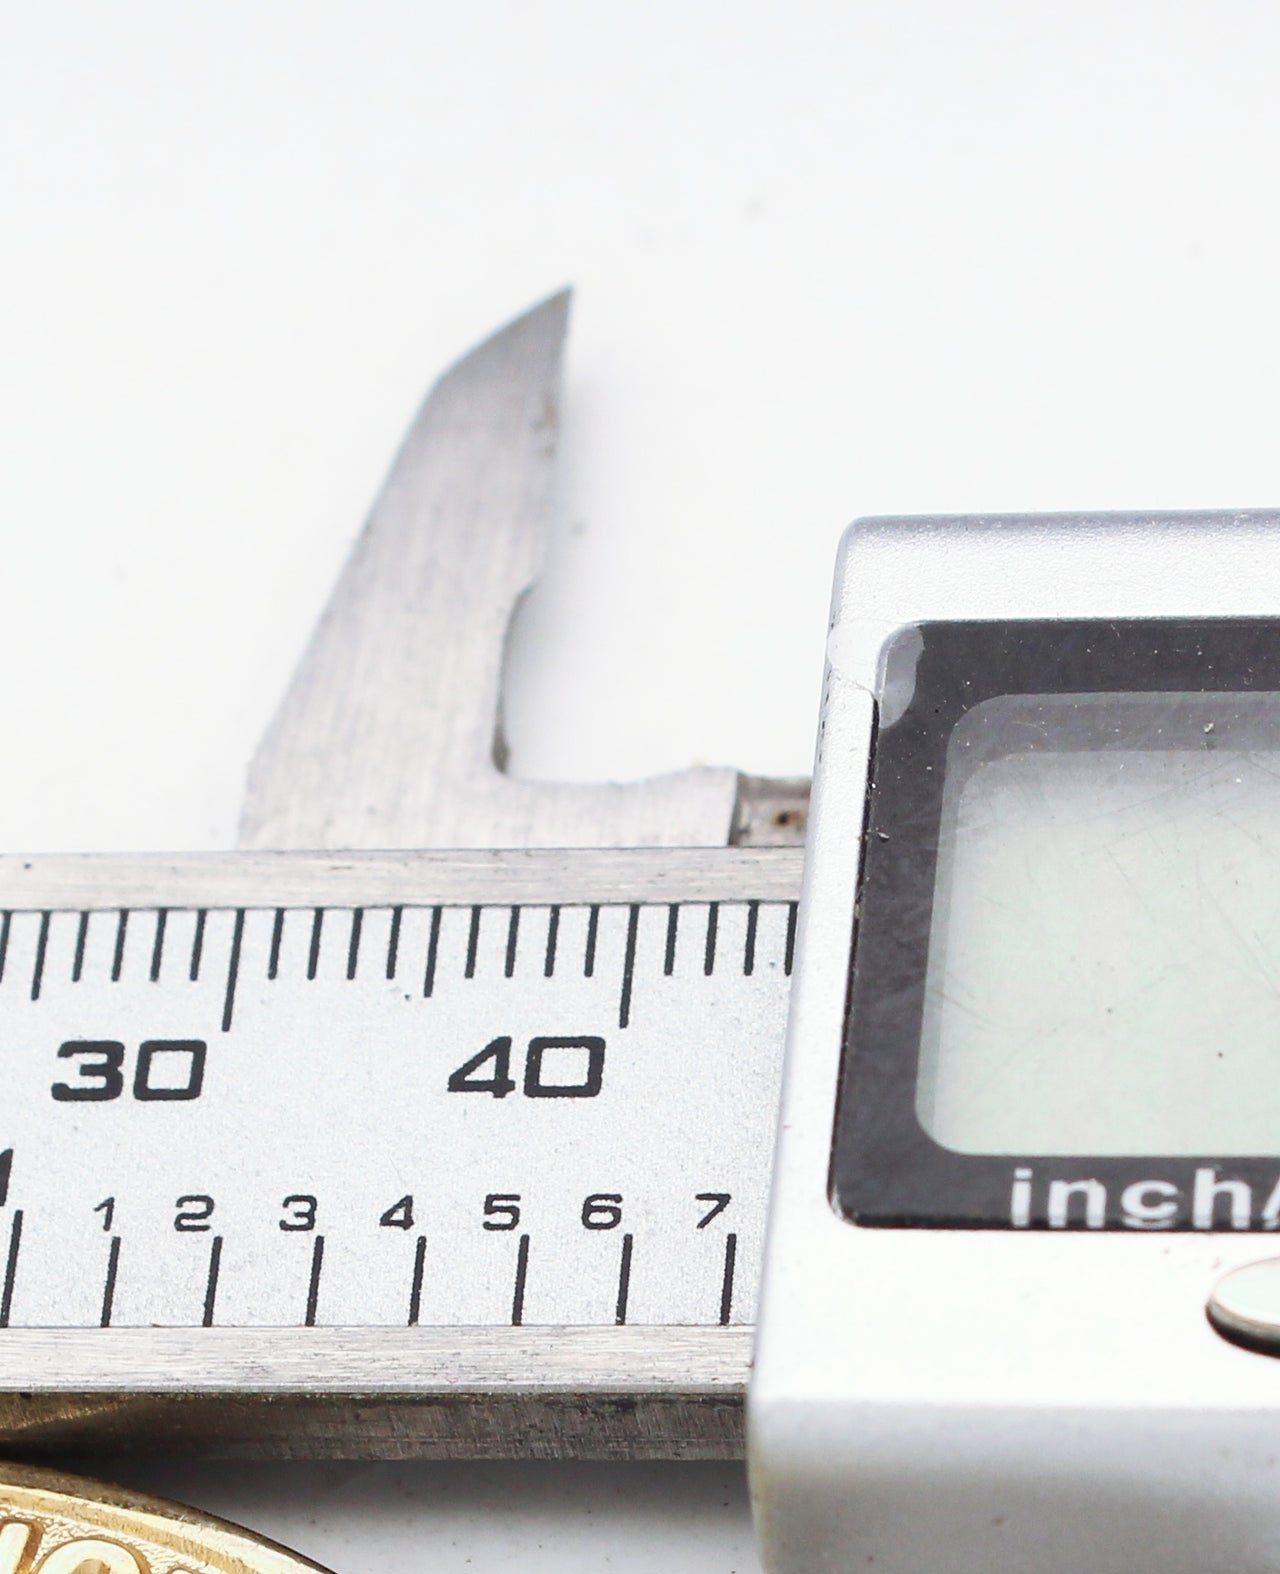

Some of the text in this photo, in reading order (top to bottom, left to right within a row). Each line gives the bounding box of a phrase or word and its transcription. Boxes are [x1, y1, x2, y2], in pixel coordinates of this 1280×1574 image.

[51, 1040, 207, 1101] 30
[448, 1036, 605, 1098] 40
[94, 1197, 115, 1232] 1
[174, 1195, 214, 1232] 2
[279, 1195, 317, 1231] 3
[379, 1195, 415, 1230] 4
[483, 1194, 520, 1231] 5
[581, 1194, 622, 1230] 6
[696, 1193, 731, 1229] 7
